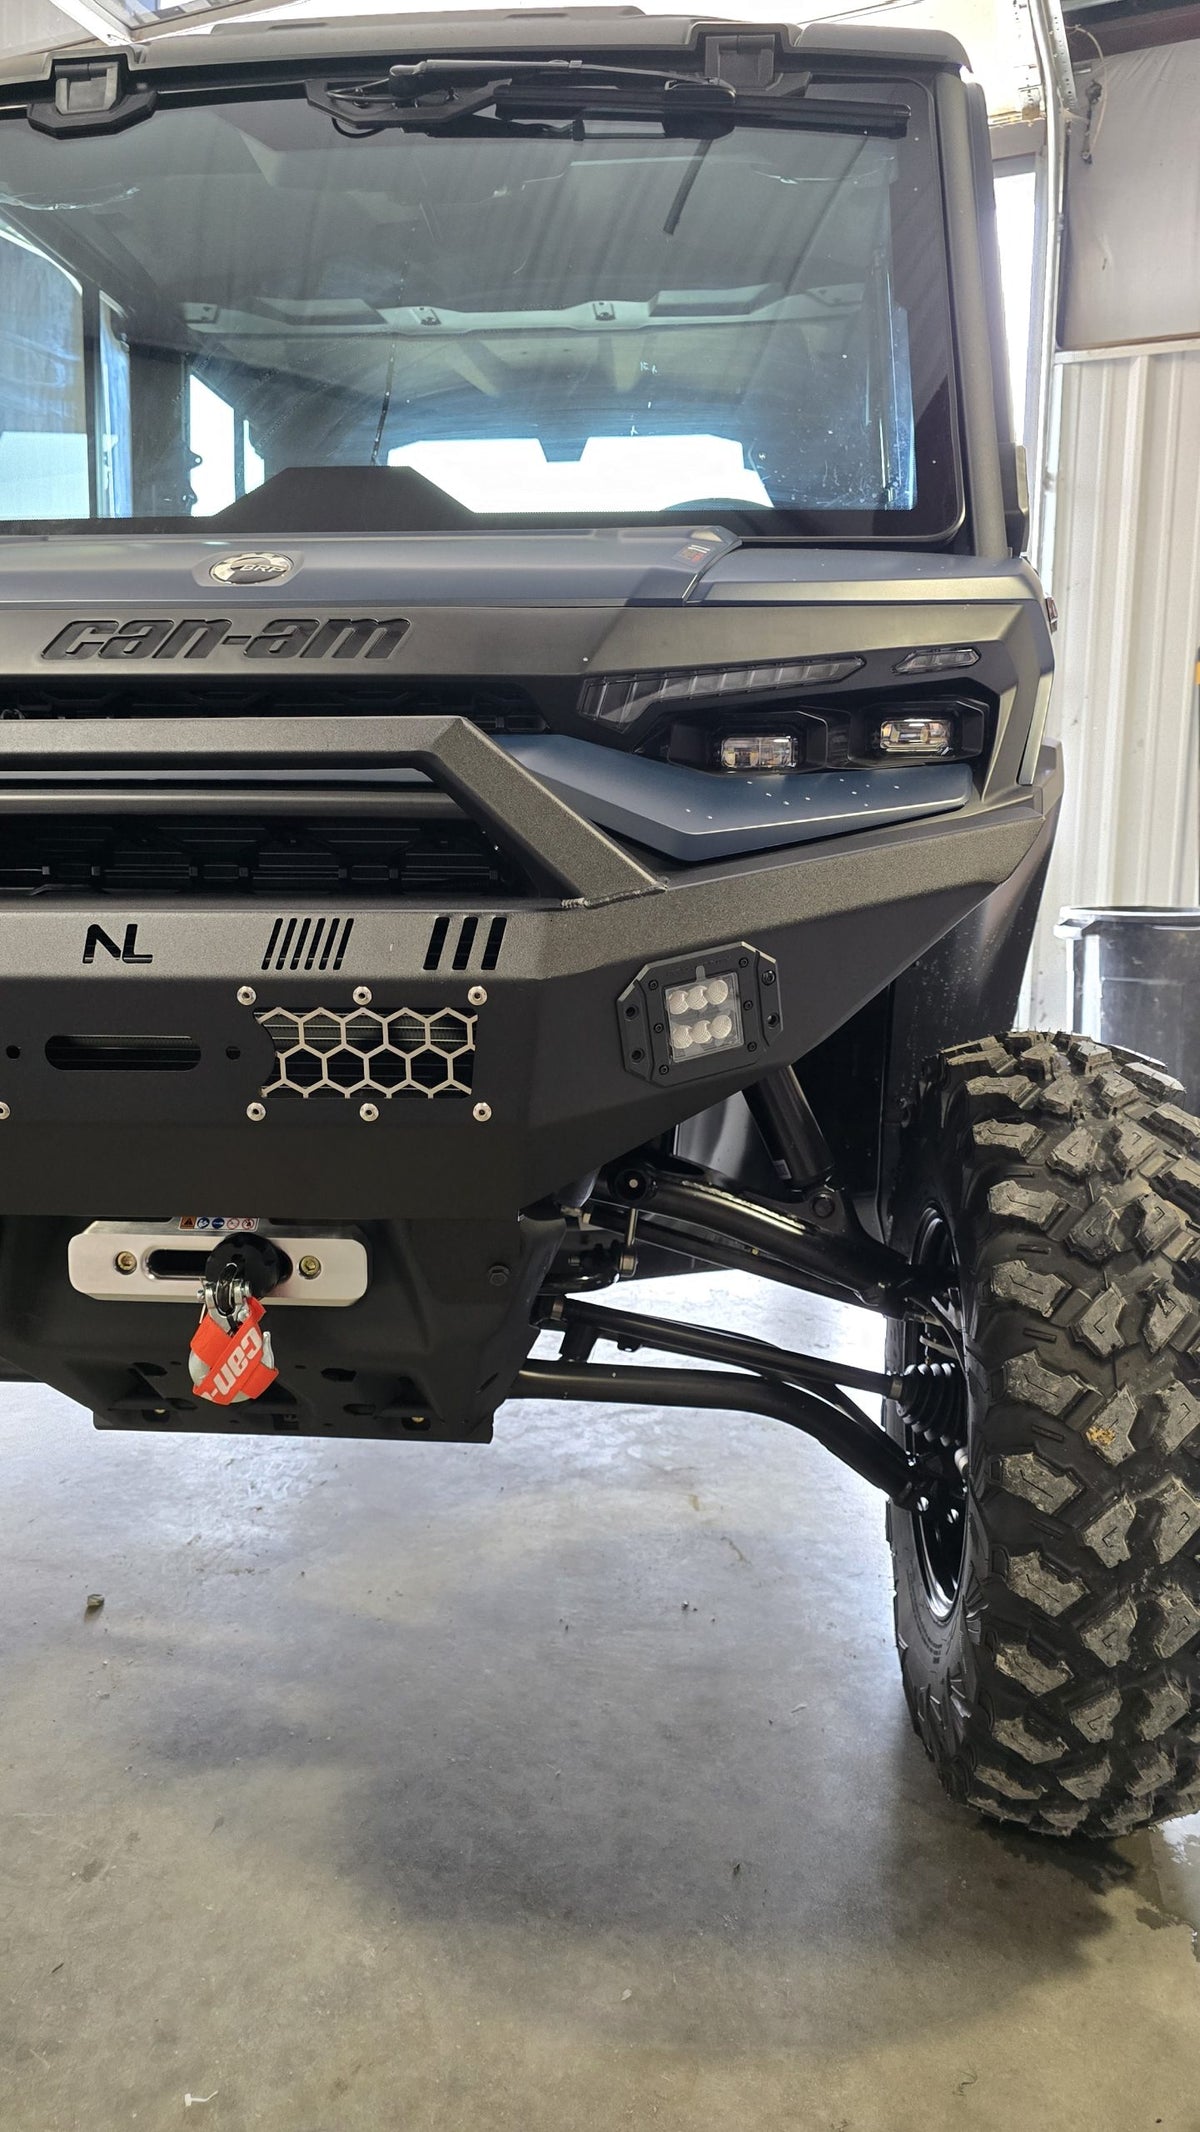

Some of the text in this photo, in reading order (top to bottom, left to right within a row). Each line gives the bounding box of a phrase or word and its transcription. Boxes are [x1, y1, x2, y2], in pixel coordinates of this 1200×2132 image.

[240, 564, 284, 573] BRP
[40, 618, 412, 660] can-am
[82, 923, 153, 963] NL
